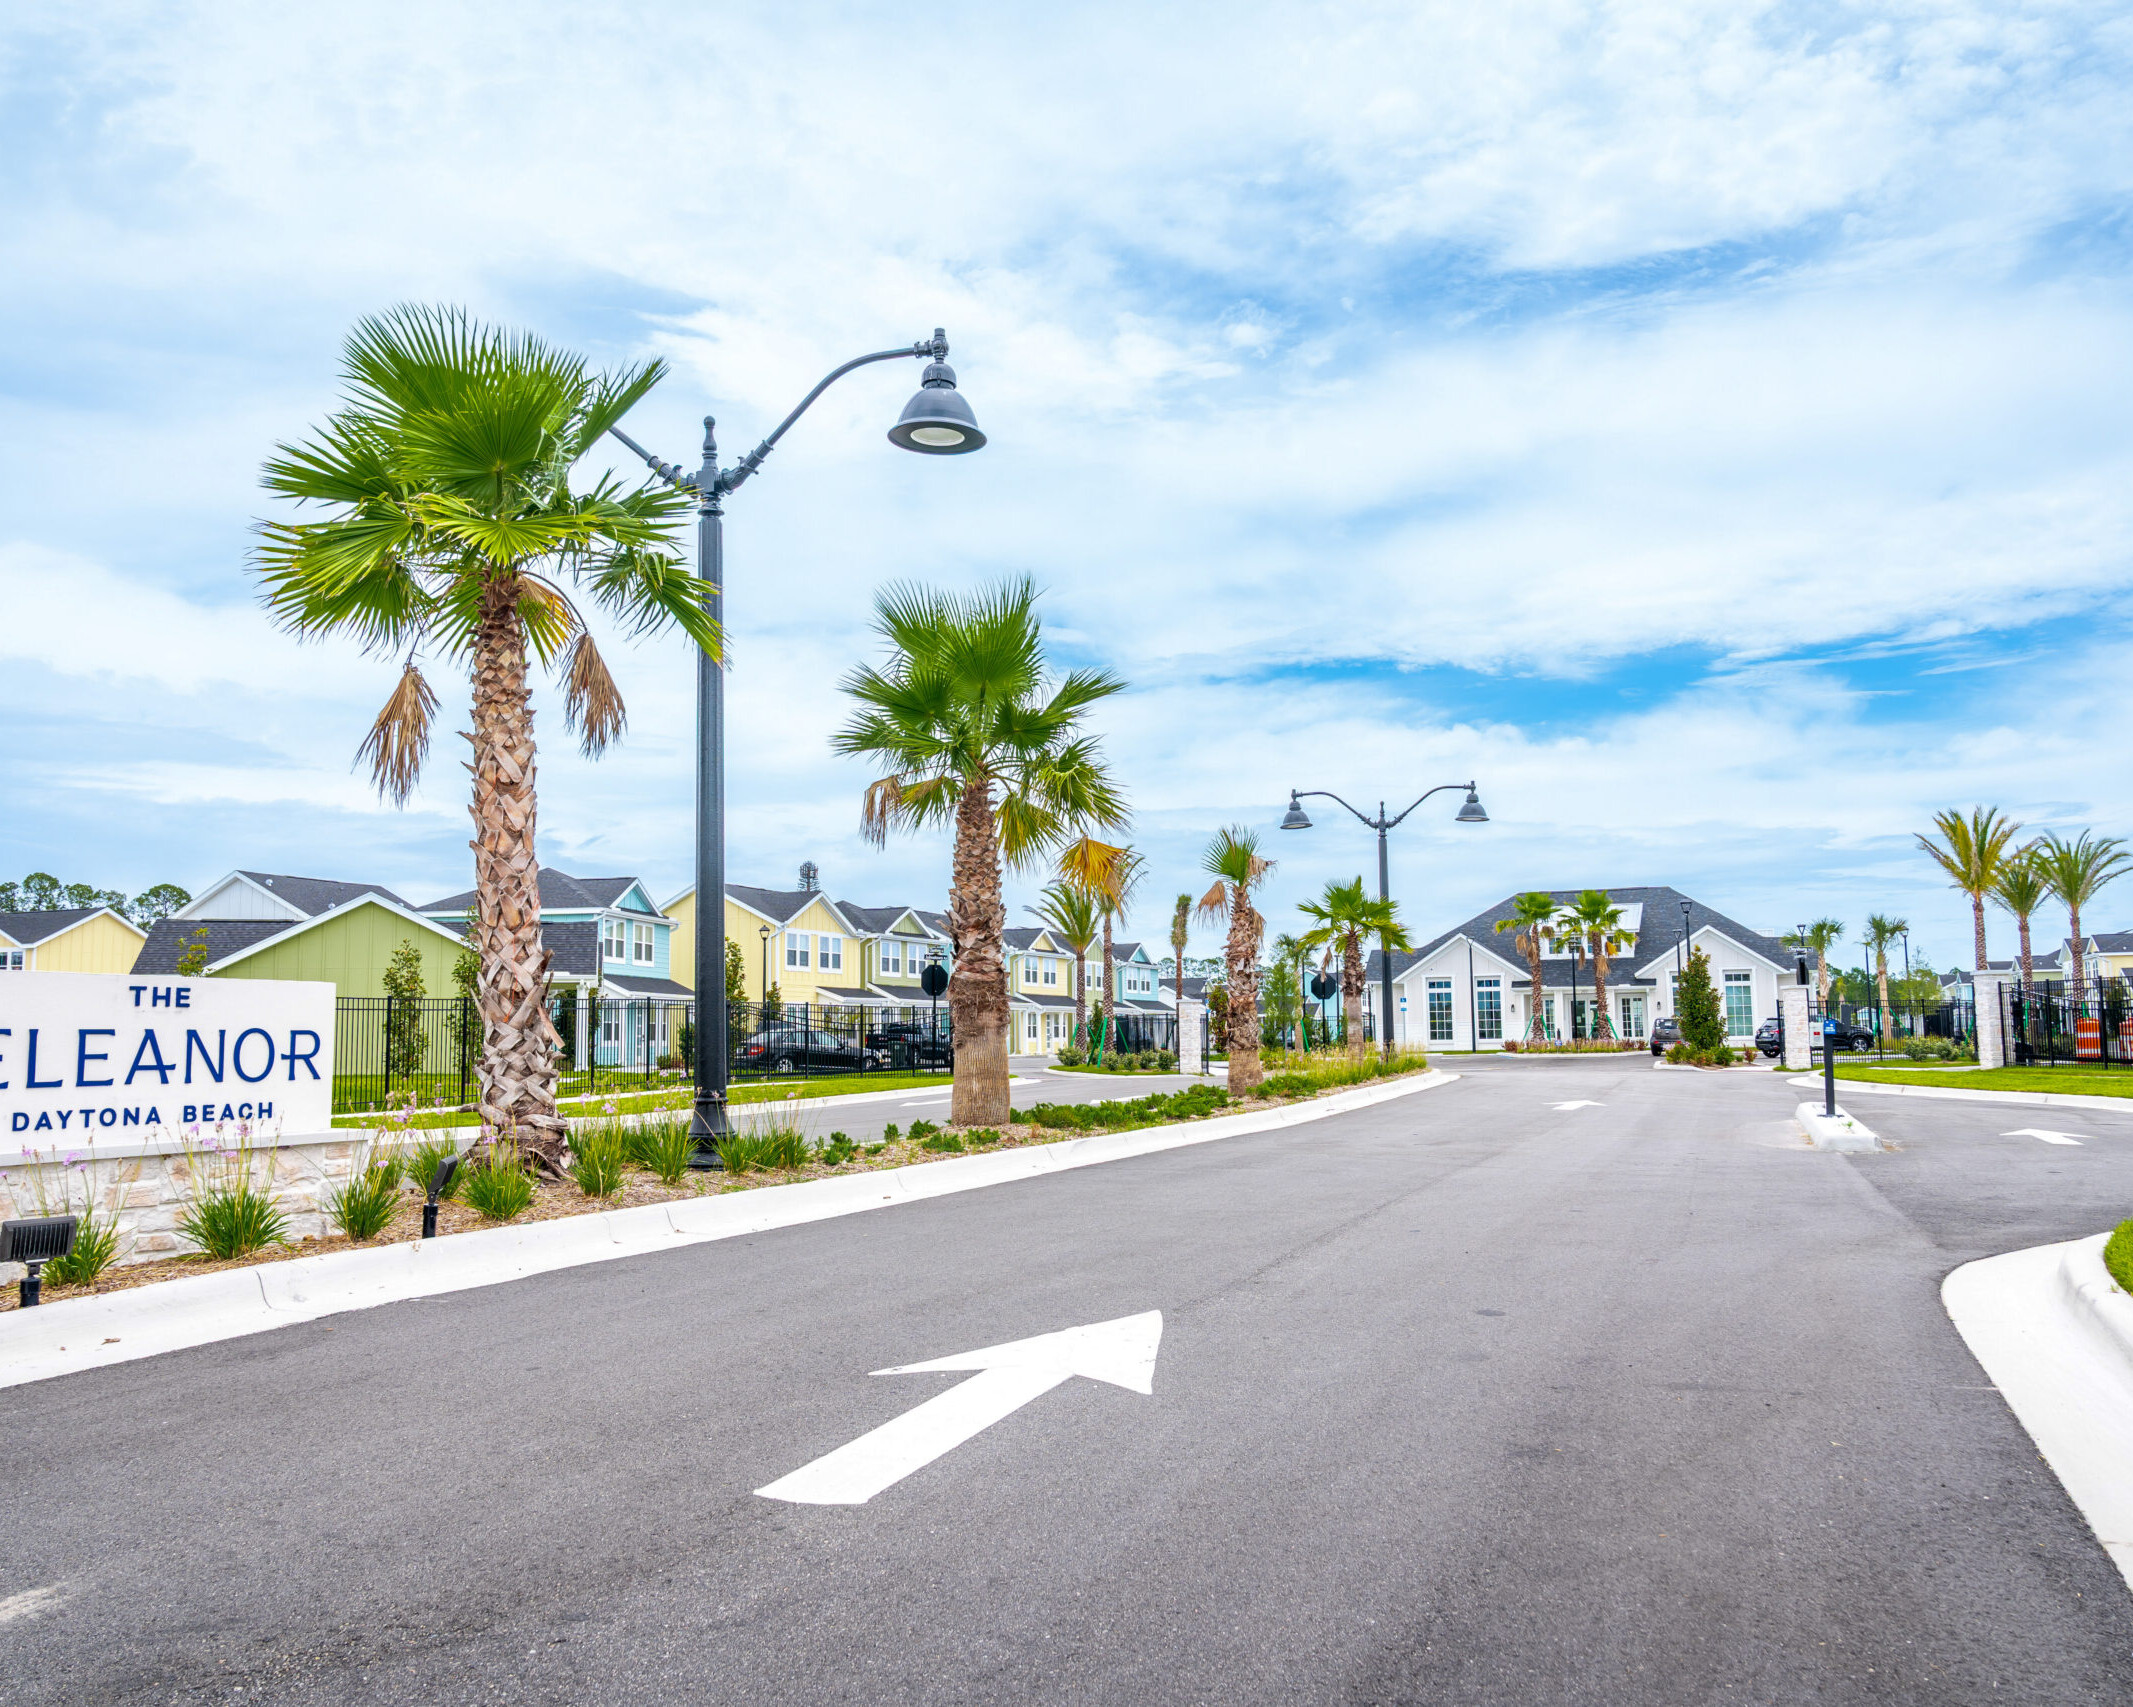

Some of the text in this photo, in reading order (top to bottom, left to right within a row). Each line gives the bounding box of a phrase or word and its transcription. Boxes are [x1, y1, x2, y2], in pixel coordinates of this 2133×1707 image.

[129, 985, 192, 1008] THE
[12, 1101, 273, 1132] DAYTONA BEACH
